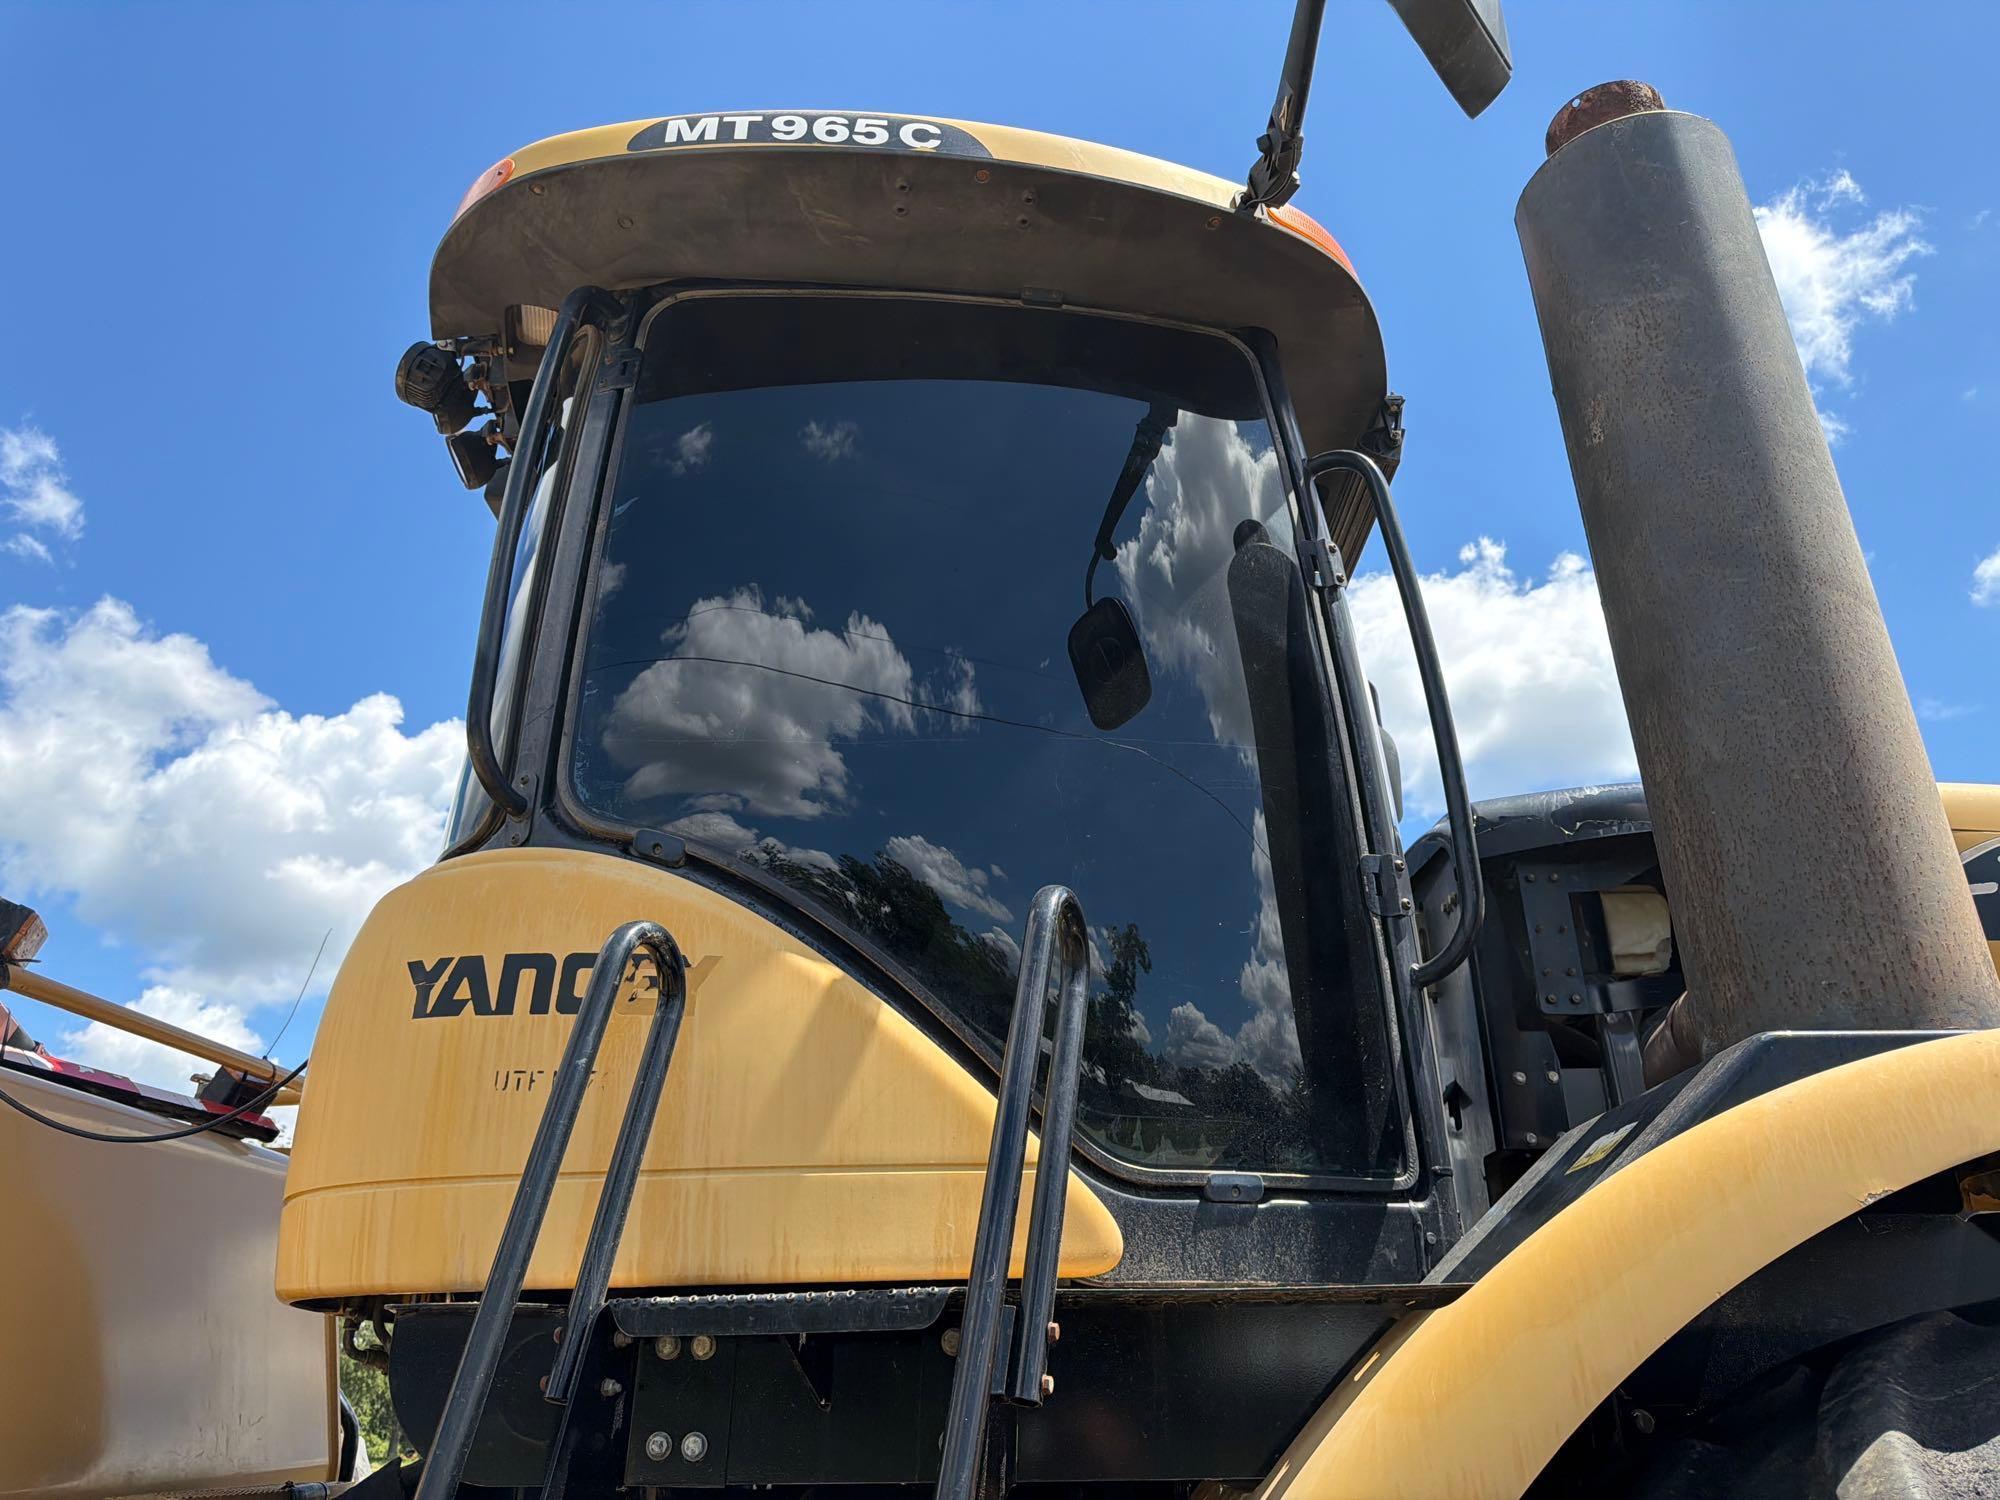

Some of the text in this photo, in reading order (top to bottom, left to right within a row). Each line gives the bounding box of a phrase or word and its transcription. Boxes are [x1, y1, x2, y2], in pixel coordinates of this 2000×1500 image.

[664, 115, 942, 149] MT 965 C
